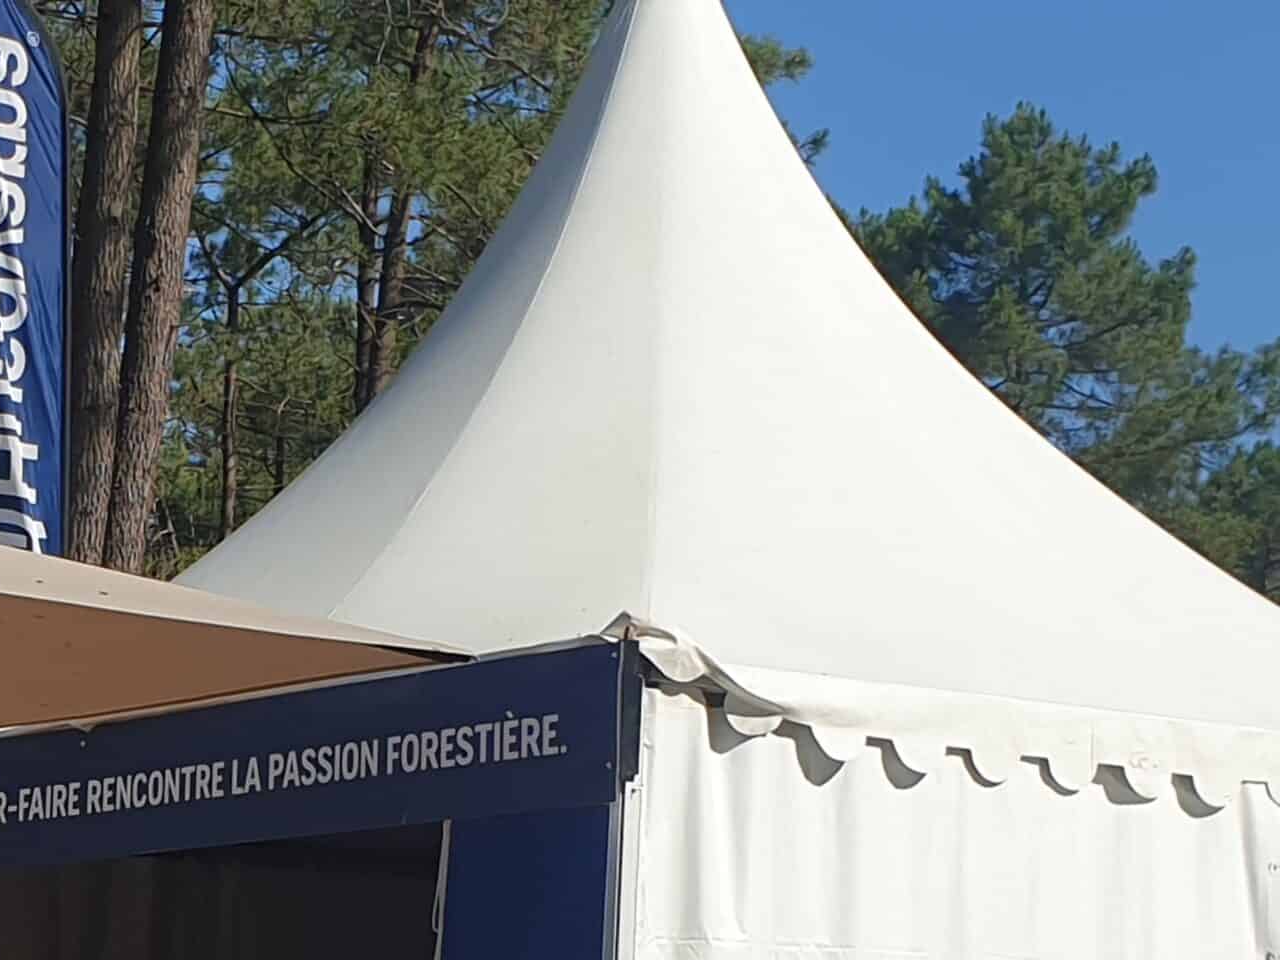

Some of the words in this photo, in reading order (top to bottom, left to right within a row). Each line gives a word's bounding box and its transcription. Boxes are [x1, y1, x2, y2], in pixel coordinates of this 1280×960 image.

[86, 761, 225, 815] RENCONTRE
[231, 756, 261, 795] LA
[269, 738, 379, 791] PASSION
[386, 711, 567, 775] FORESTIÈRE.
